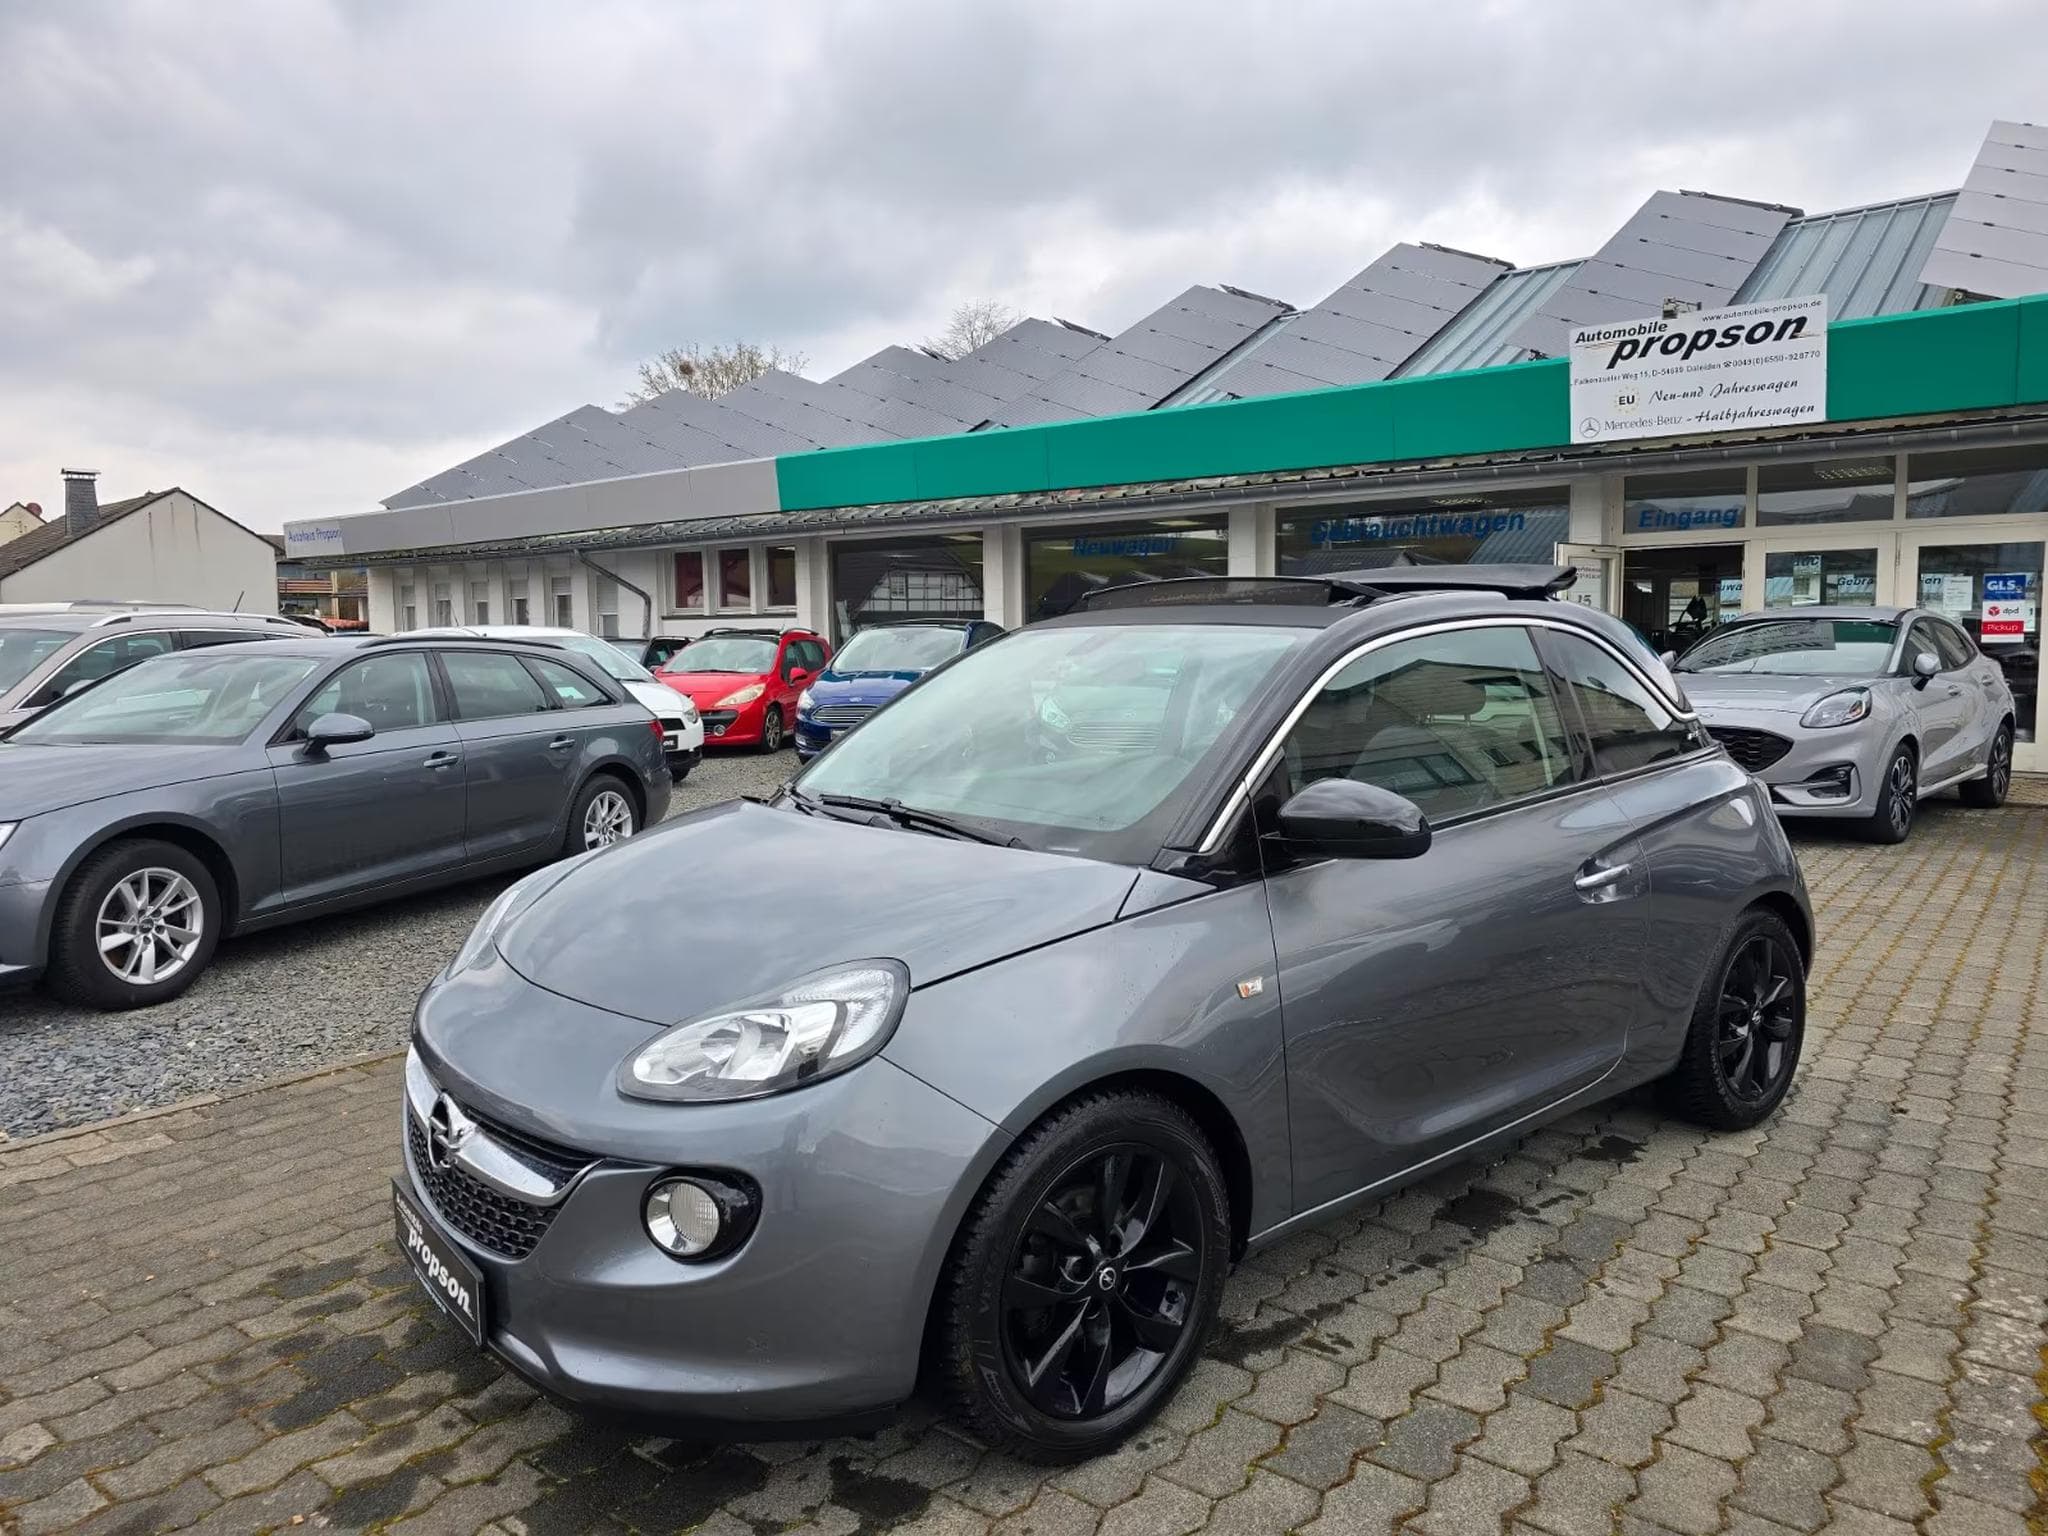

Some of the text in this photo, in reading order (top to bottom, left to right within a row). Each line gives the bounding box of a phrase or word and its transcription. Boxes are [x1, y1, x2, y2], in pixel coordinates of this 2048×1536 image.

[1702, 299, 1822, 322] www.automobile-propson.de
[1575, 321, 1668, 344] Automobile
[1606, 316, 1808, 370] propson
[1618, 394, 1636, 406] EU
[1648, 379, 1798, 405] Neu-und Jahreswagen
[1604, 415, 1683, 431] Mercedes-Benz
[1312, 510, 1526, 545] Gebrauchtwagen
[1638, 508, 1740, 530] Eingang
[1073, 536, 1177, 560] Neuwagen
[1986, 580, 2017, 591] GLS
[2002, 606, 2020, 615] dpd
[1986, 623, 2019, 632] Pickup
[407, 1227, 472, 1314] propson
